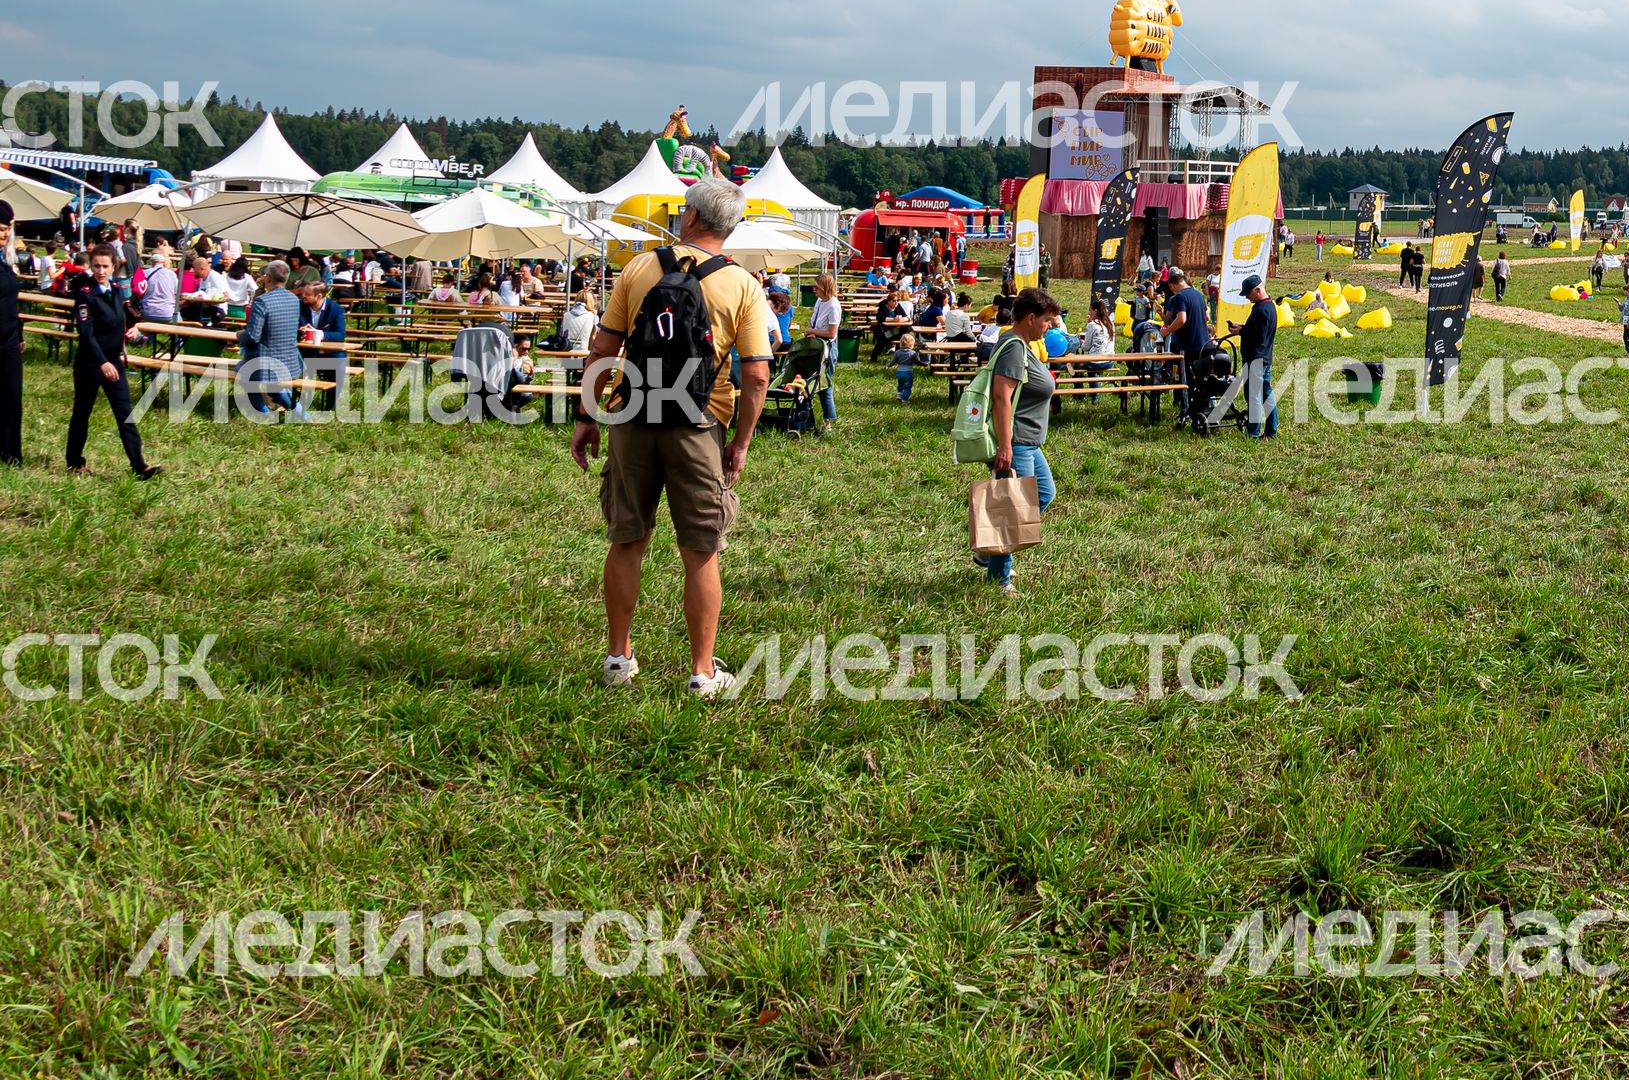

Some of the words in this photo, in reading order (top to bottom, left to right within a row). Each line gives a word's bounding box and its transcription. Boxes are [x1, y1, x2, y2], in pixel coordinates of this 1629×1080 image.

[1072, 126, 1103, 137] СЫР
[1071, 140, 1103, 152] ПИР
[1070, 154, 1102, 166] МИР
[911, 200, 949, 209] ПОМИДОР
